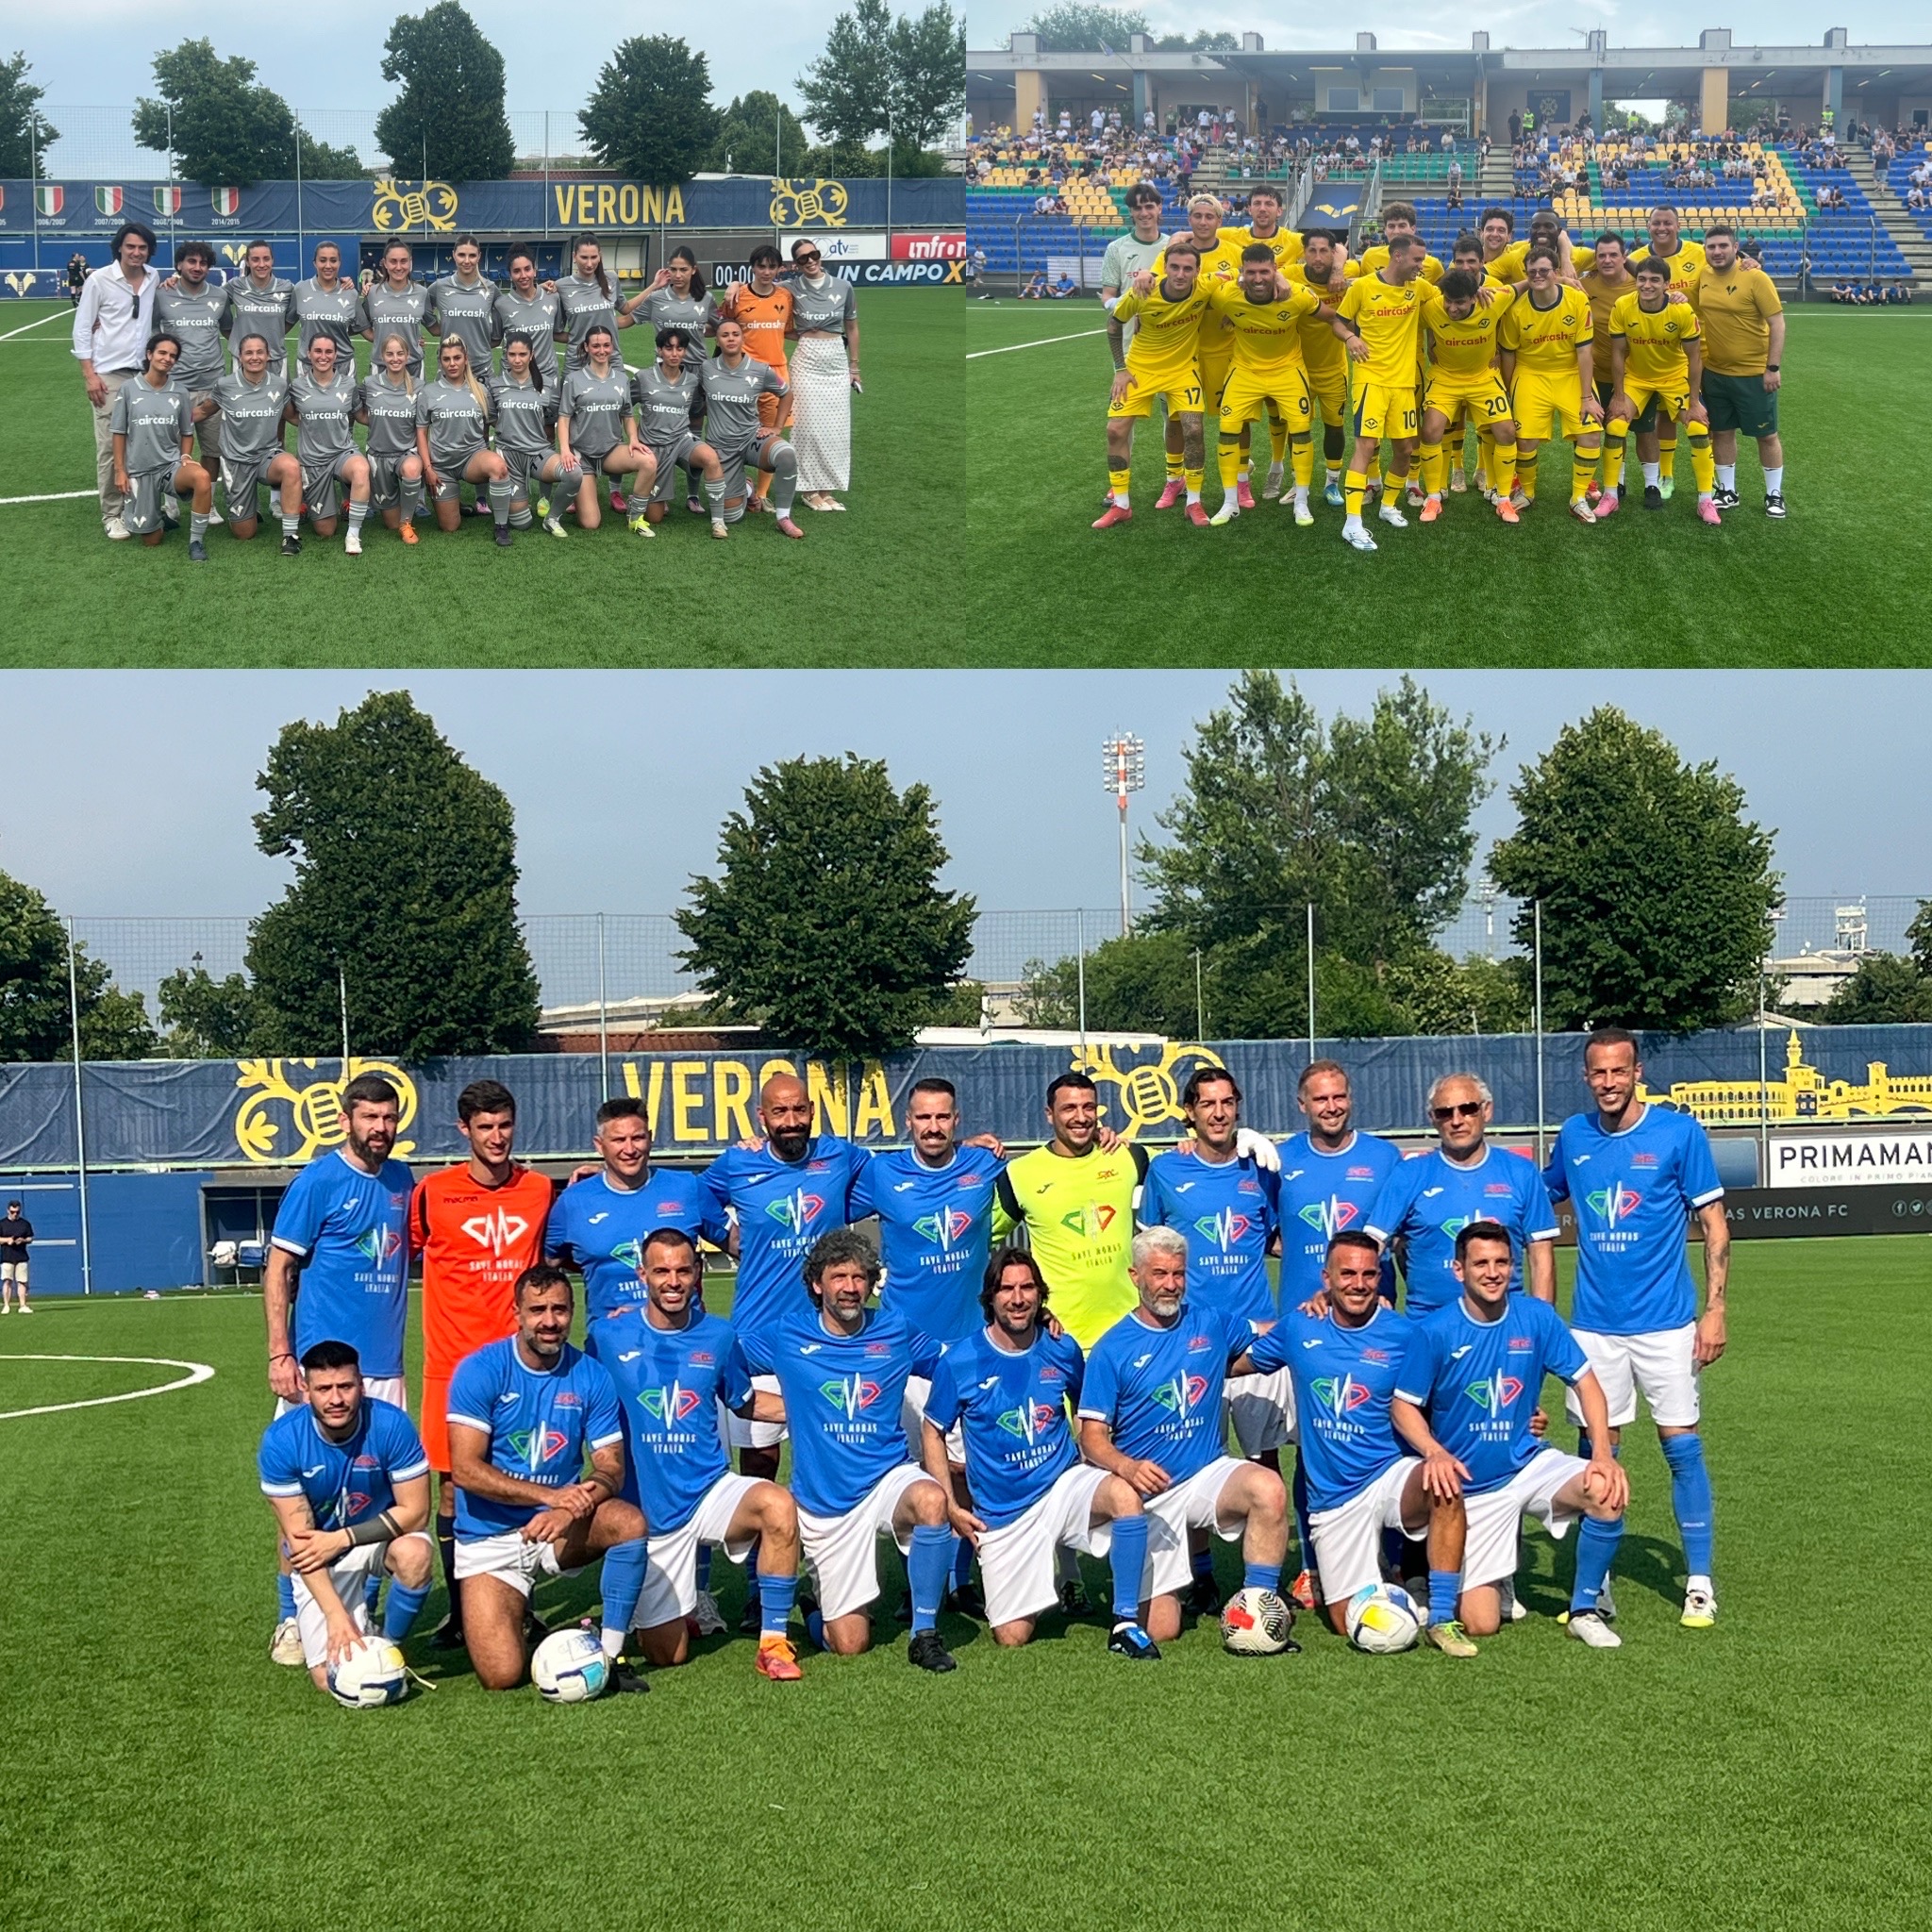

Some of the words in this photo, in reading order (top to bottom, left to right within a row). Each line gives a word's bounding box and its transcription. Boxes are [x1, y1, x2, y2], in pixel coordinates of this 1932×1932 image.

[555, 185, 685, 225] VERONA
[829, 240, 848, 256] atv
[715, 265, 755, 286] 00:00
[837, 265, 860, 282] IN
[865, 264, 943, 282] CAMPO
[243, 304, 281, 313] aircash
[448, 308, 485, 318] aircash
[575, 301, 610, 314] aircash
[176, 318, 214, 327] aircash
[306, 312, 343, 322] aircash
[378, 314, 415, 325] aircash
[1157, 314, 1198, 330] aircash
[663, 319, 699, 329] aircash
[747, 319, 782, 329] aircash
[1243, 326, 1286, 335] aircash
[1445, 335, 1488, 347] aircash
[712, 393, 750, 404] aircash
[1184, 387, 1201, 405] 17
[502, 401, 540, 412] aircash
[1298, 396, 1309, 415] 9
[1485, 396, 1507, 417] 20
[236, 408, 275, 418] aircash
[305, 409, 342, 420] aircash
[374, 408, 411, 419] aircash
[440, 408, 476, 419] aircash
[139, 414, 175, 425] aircash
[1403, 409, 1416, 429] 10
[1752, 1206, 1822, 1221] VERONA
[1828, 1205, 1848, 1217] FC
[848, 1423, 877, 1434] MORAS
[667, 1433, 696, 1443] MORAS
[654, 1443, 684, 1454] ITALIA
